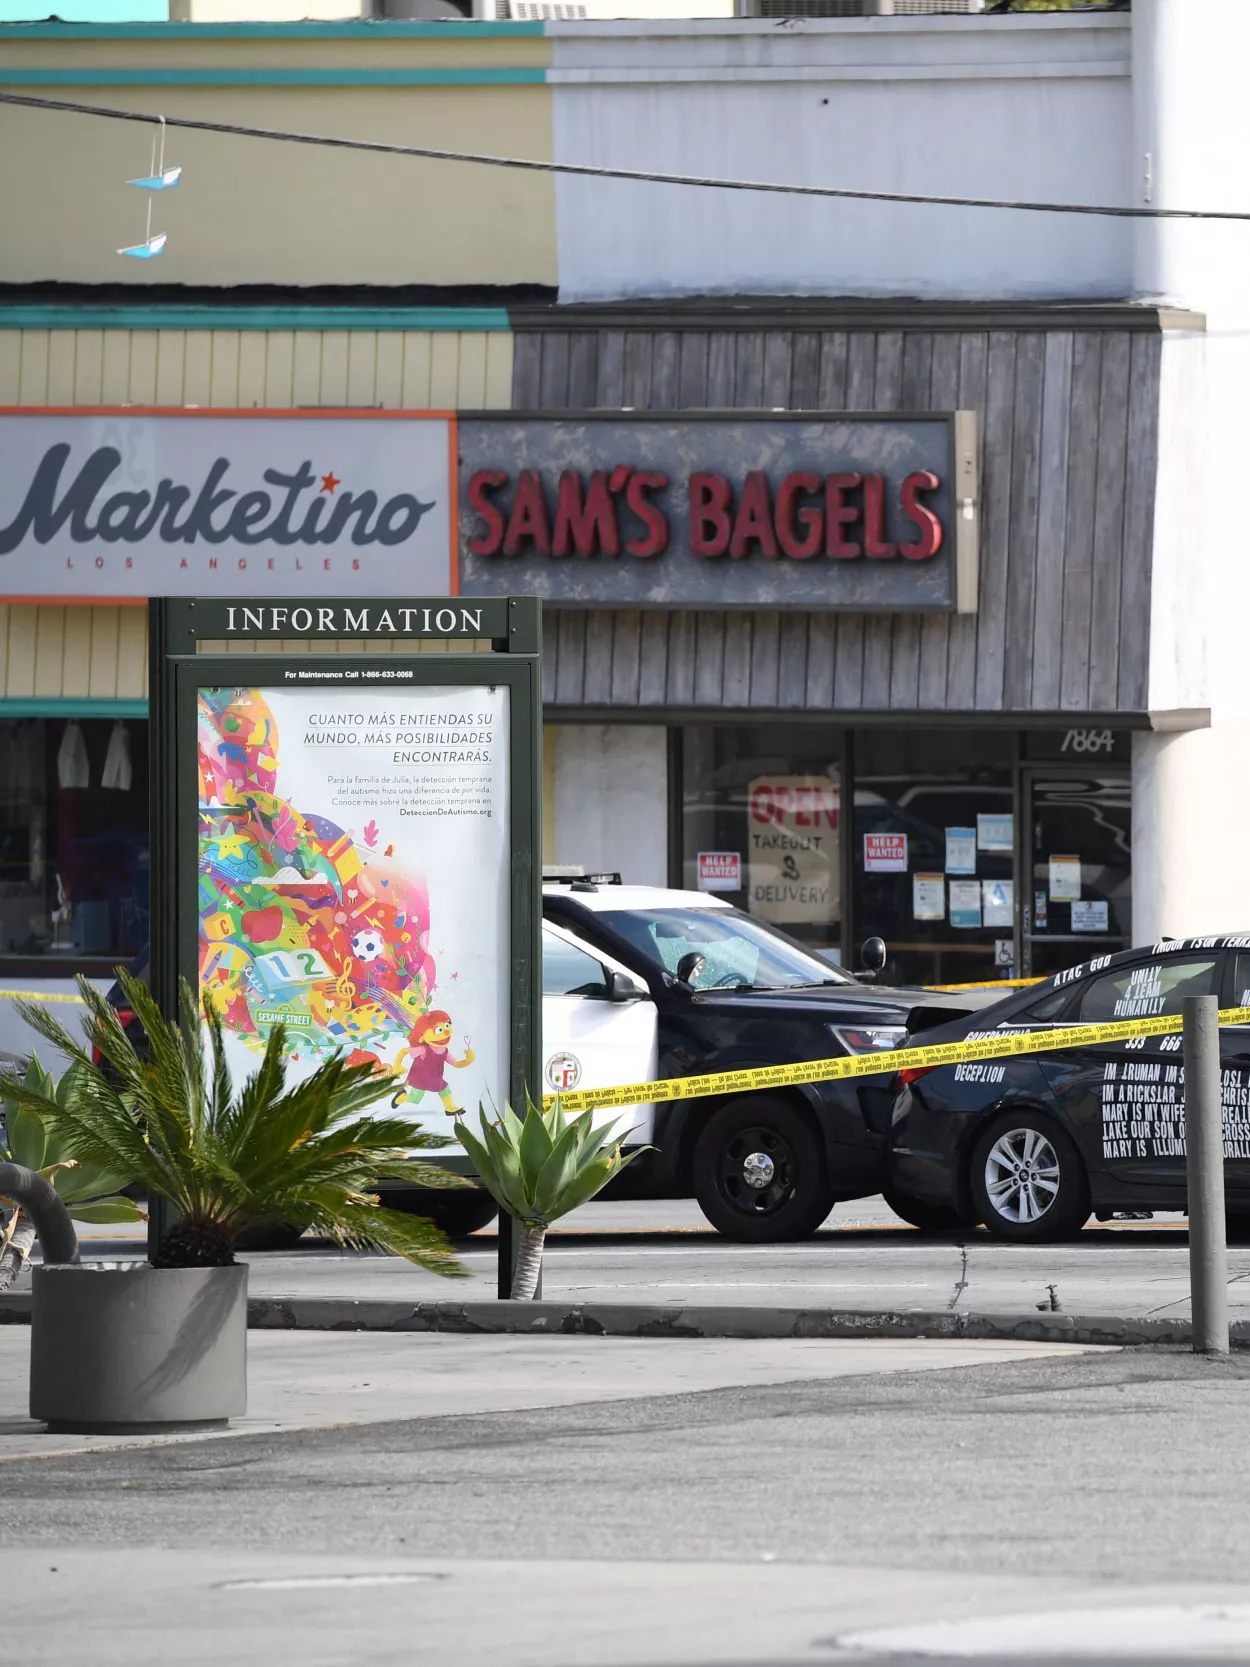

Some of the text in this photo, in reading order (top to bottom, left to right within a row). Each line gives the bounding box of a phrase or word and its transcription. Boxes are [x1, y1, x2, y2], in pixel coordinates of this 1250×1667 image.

[0, 442, 436, 556] Marketino
[467, 464, 943, 561] SAM'S BAGELS
[67, 557, 360, 571] LOS ANGELES
[226, 607, 484, 633] INFORMATION
[285, 671, 297, 679] For
[298, 671, 343, 679] Maintenance
[345, 671, 359, 679] Call
[308, 711, 493, 726] CUANTO MÁS ENTIENDAS SU
[304, 730, 493, 747] MUNDO, MÁS POSIBILIDADES
[393, 748, 492, 763] ENCONTRARÁS.
[327, 775, 492, 785] Para la familia de Julia, la detección temprana
[337, 787, 349, 795] del
[350, 787, 380, 795] autismo
[381, 787, 397, 795] hizo
[414, 786, 450, 794] diferencia
[452, 786, 460, 794] de
[461, 787, 473, 796] por
[331, 798, 362, 806] Conoce
[363, 798, 379, 806] más
[380, 797, 400, 805] sobre
[401, 797, 408, 805] la
[410, 797, 446, 805] detección
[447, 798, 481, 807] temprana
[752, 785, 839, 830] OPEN
[400, 808, 492, 818] DeteccionDeAutismo.org
[752, 834, 823, 850] TAKEOUT
[872, 837, 899, 847] HELP
[705, 856, 733, 866] HELP
[868, 848, 903, 858] WANTED
[701, 866, 737, 877] WANTED
[755, 885, 828, 904] DELIVERY
[1053, 954, 1112, 987] ATAC GOD
[1130, 965, 1163, 986] UNITY
[1133, 981, 1162, 1000] TEAM
[1113, 997, 1166, 1017] HUMANITY
[285, 1013, 312, 1026] STREET
[954, 1063, 1006, 1083] DECEPTION
[1103, 1062, 1117, 1080] IM
[1121, 1062, 1161, 1081] TRUMAN
[1164, 1065, 1178, 1083] IM
[1102, 1084, 1114, 1103] IM
[1102, 1103, 1129, 1122] MARY
[1132, 1103, 1142, 1121] IS
[1144, 1103, 1159, 1122] MY
[1160, 1104, 1186, 1122] WIFE
[1102, 1120, 1128, 1141] TAKE
[1130, 1120, 1152, 1139] OUR
[1154, 1120, 1175, 1139] SON
[1103, 1139, 1132, 1159] MARY
[1135, 1139, 1147, 1157] IS
